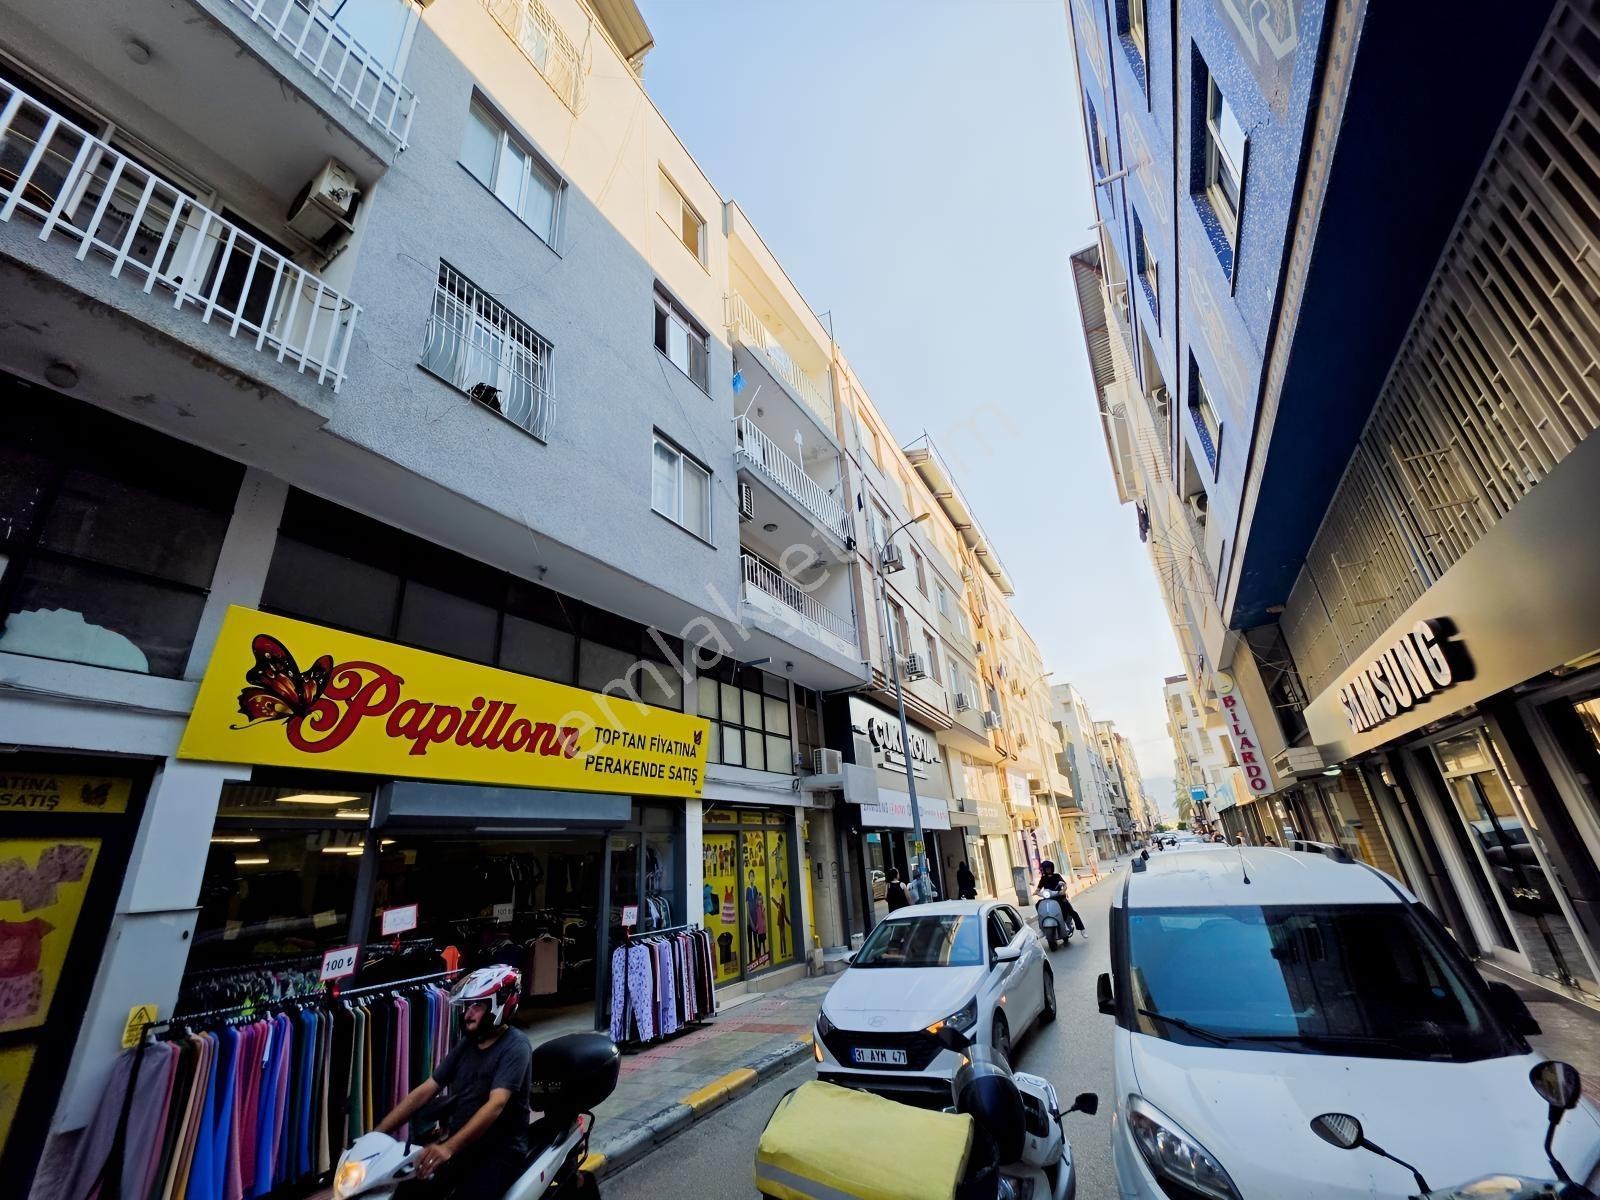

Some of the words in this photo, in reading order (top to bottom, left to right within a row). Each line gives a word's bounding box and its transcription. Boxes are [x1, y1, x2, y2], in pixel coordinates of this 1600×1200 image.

[1337, 620, 1452, 735] SAMSUNG
[286, 660, 581, 760] Papillonn
[594, 726, 646, 751] TOPTAN
[649, 734, 697, 758] FİYATINA
[584, 754, 665, 780] PERAKENDE
[668, 765, 698, 786] SATIŞ
[326, 958, 344, 972] 100
[856, 1049, 865, 1061] 31
[892, 1051, 906, 1064] 471
